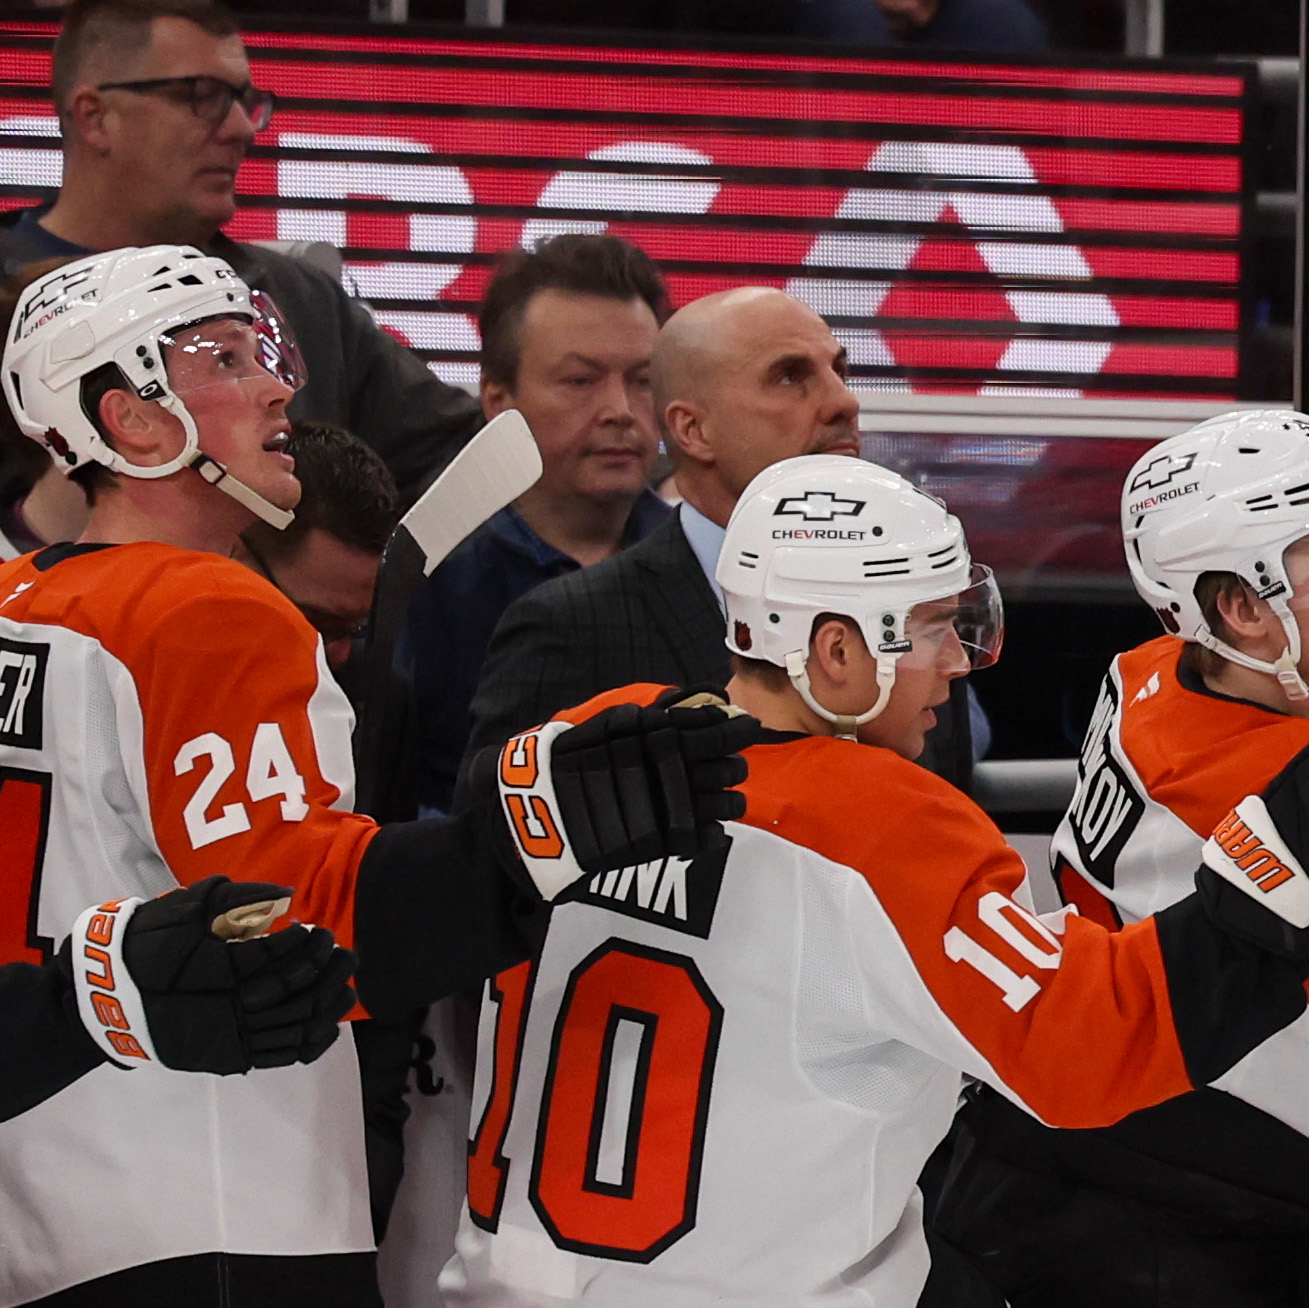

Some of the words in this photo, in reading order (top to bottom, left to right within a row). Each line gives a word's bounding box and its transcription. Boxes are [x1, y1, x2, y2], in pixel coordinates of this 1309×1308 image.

[23, 288, 100, 339] CHEVROLET
[772, 528, 867, 541] CHEVROLET
[1129, 481, 1200, 516] CHEVROLET
[173, 722, 310, 851] 24
[943, 891, 1064, 1013] 10
[467, 936, 724, 1265] 10
